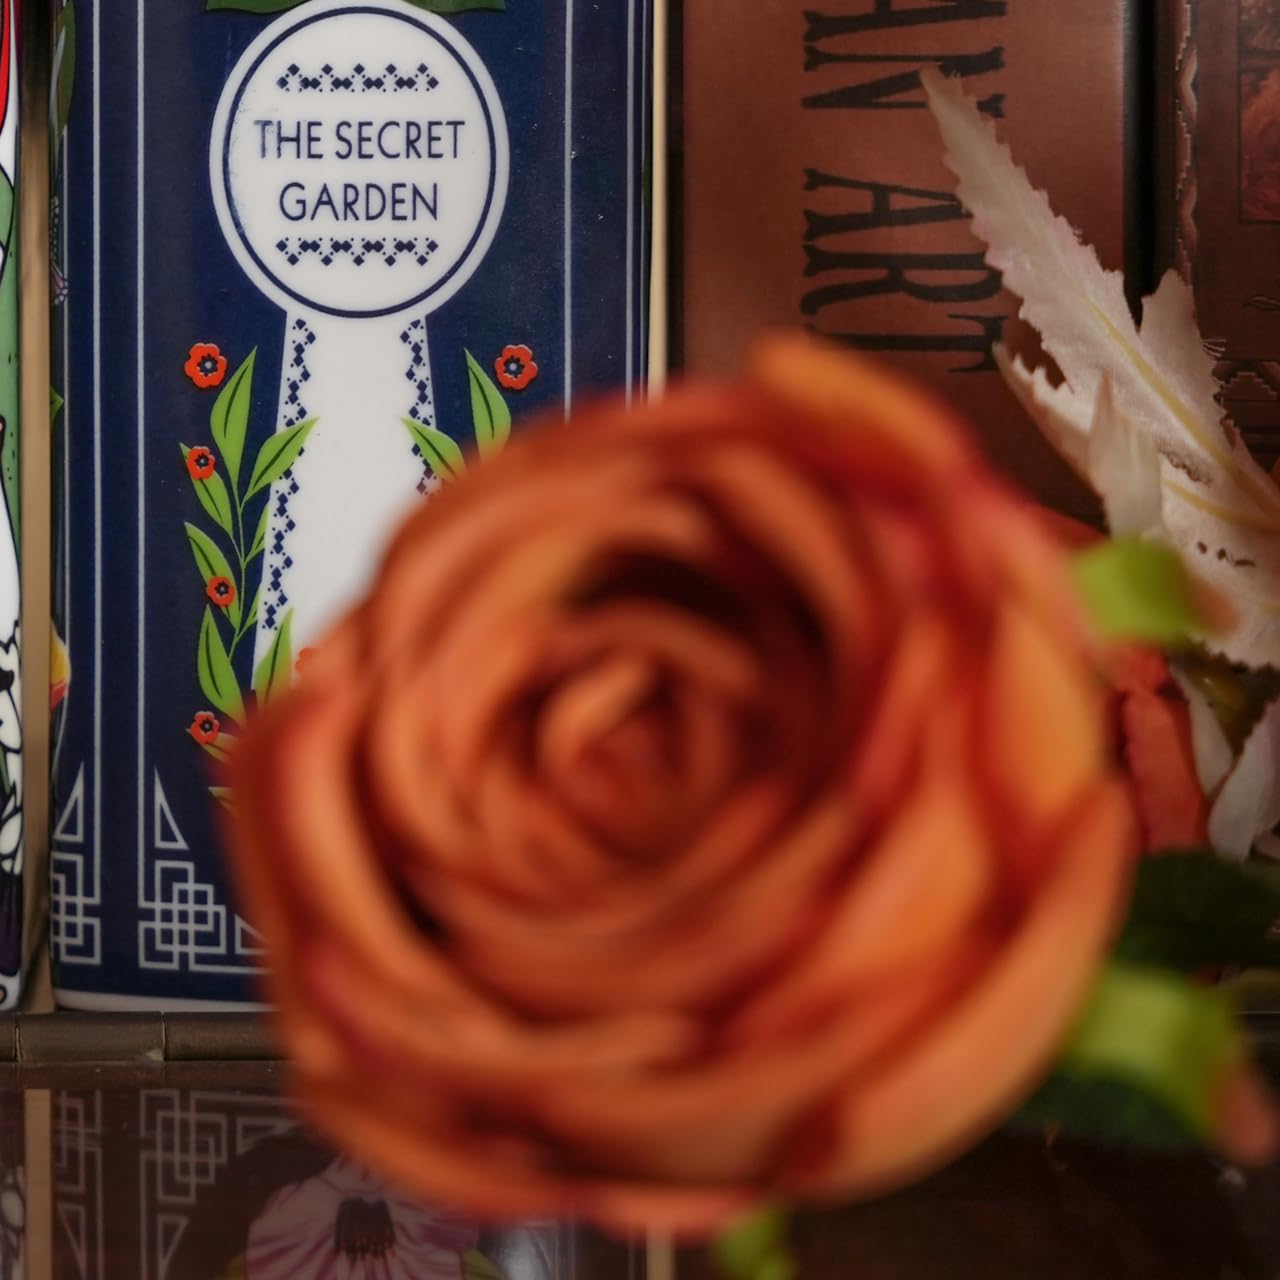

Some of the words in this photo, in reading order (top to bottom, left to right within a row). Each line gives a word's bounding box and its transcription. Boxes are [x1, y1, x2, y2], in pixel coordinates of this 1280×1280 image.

[254, 120, 324, 160] THE
[334, 120, 466, 160] SECRET
[279, 181, 438, 222] GARDEN
[800, 166, 1008, 374] ART
